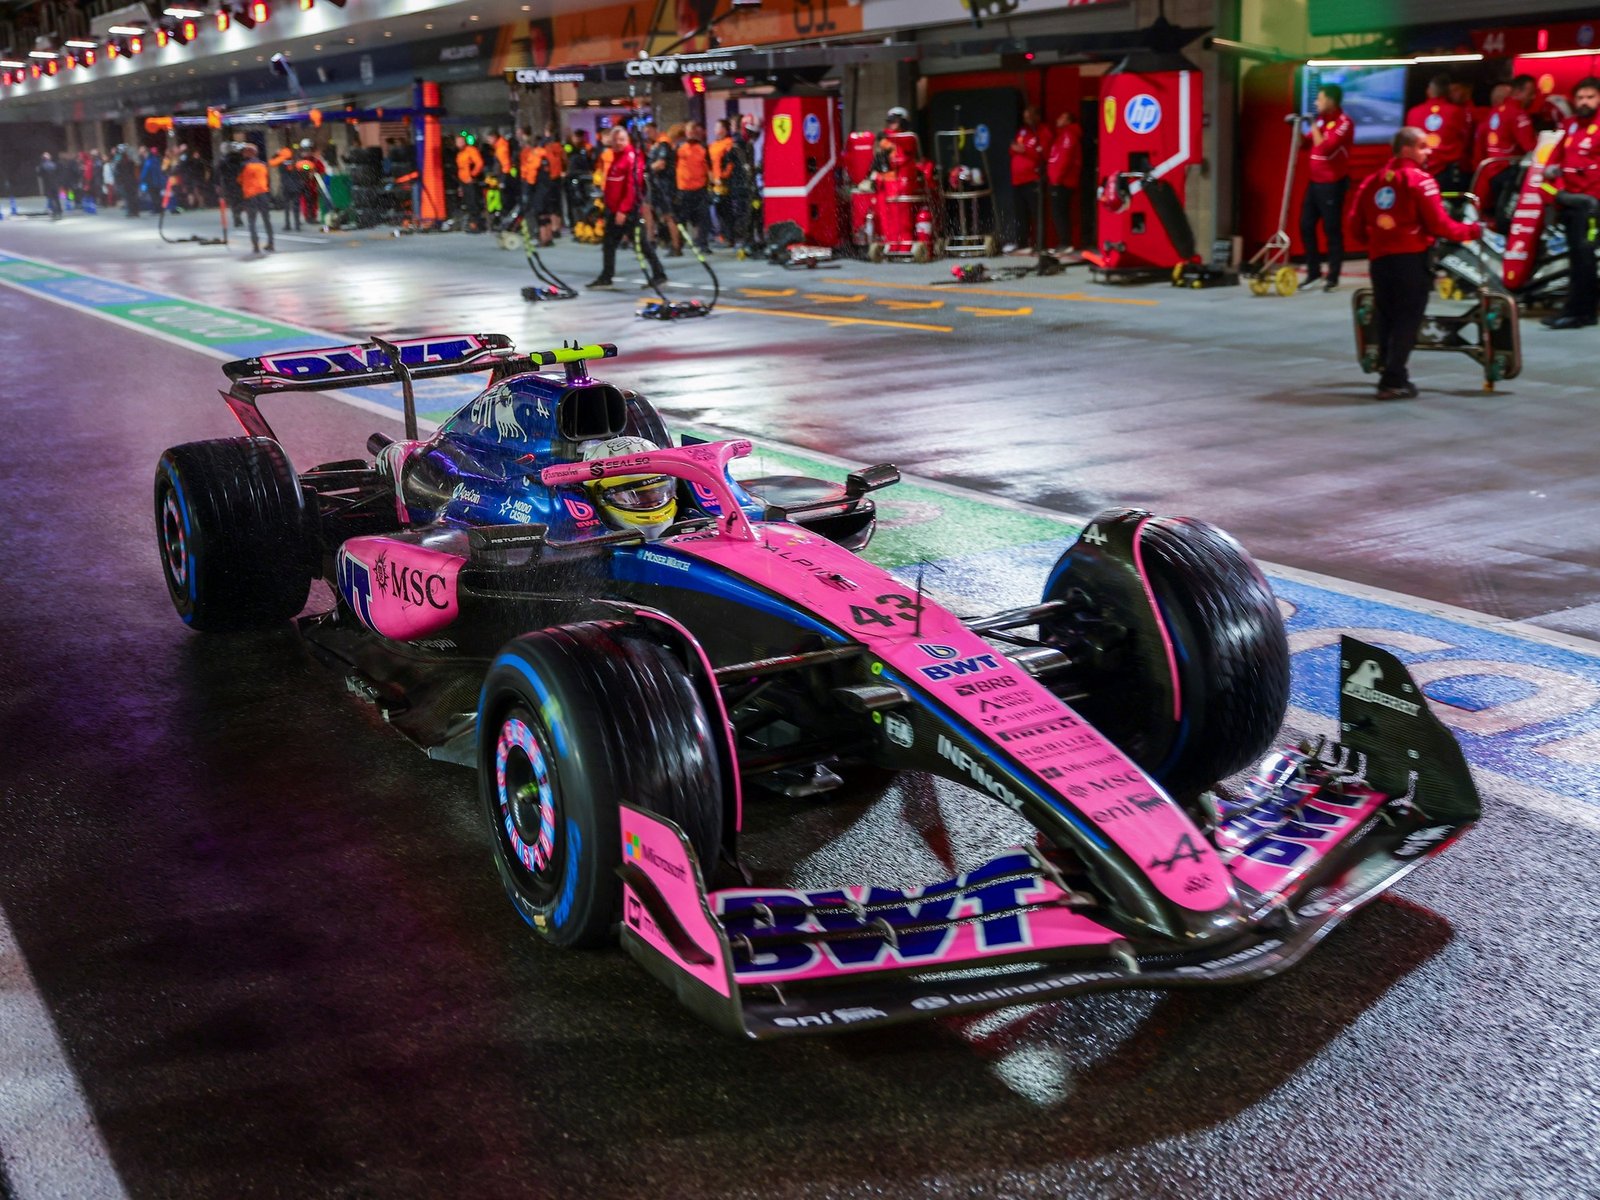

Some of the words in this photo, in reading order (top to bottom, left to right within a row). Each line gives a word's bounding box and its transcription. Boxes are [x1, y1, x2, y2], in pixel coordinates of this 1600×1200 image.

[1483, 33, 1504, 52] 44
[681, 61, 737, 73] LOGISTICS
[1130, 96, 1158, 131] hp
[509, 509, 531, 524] CASINO
[512, 499, 532, 514] MODO
[576, 519, 600, 528] BWT
[391, 561, 449, 610] MSC
[849, 594, 925, 627] 43
[919, 654, 1001, 682] BWT
[975, 675, 1018, 693] BRB
[937, 734, 1024, 809] INFINOX
[1061, 753, 1122, 774] Microsoft
[1086, 768, 1142, 793] MSC
[1092, 799, 1134, 823] eni
[641, 843, 687, 884] Microsoft
[718, 851, 1043, 976] BWT
[773, 1011, 833, 1027] eni
